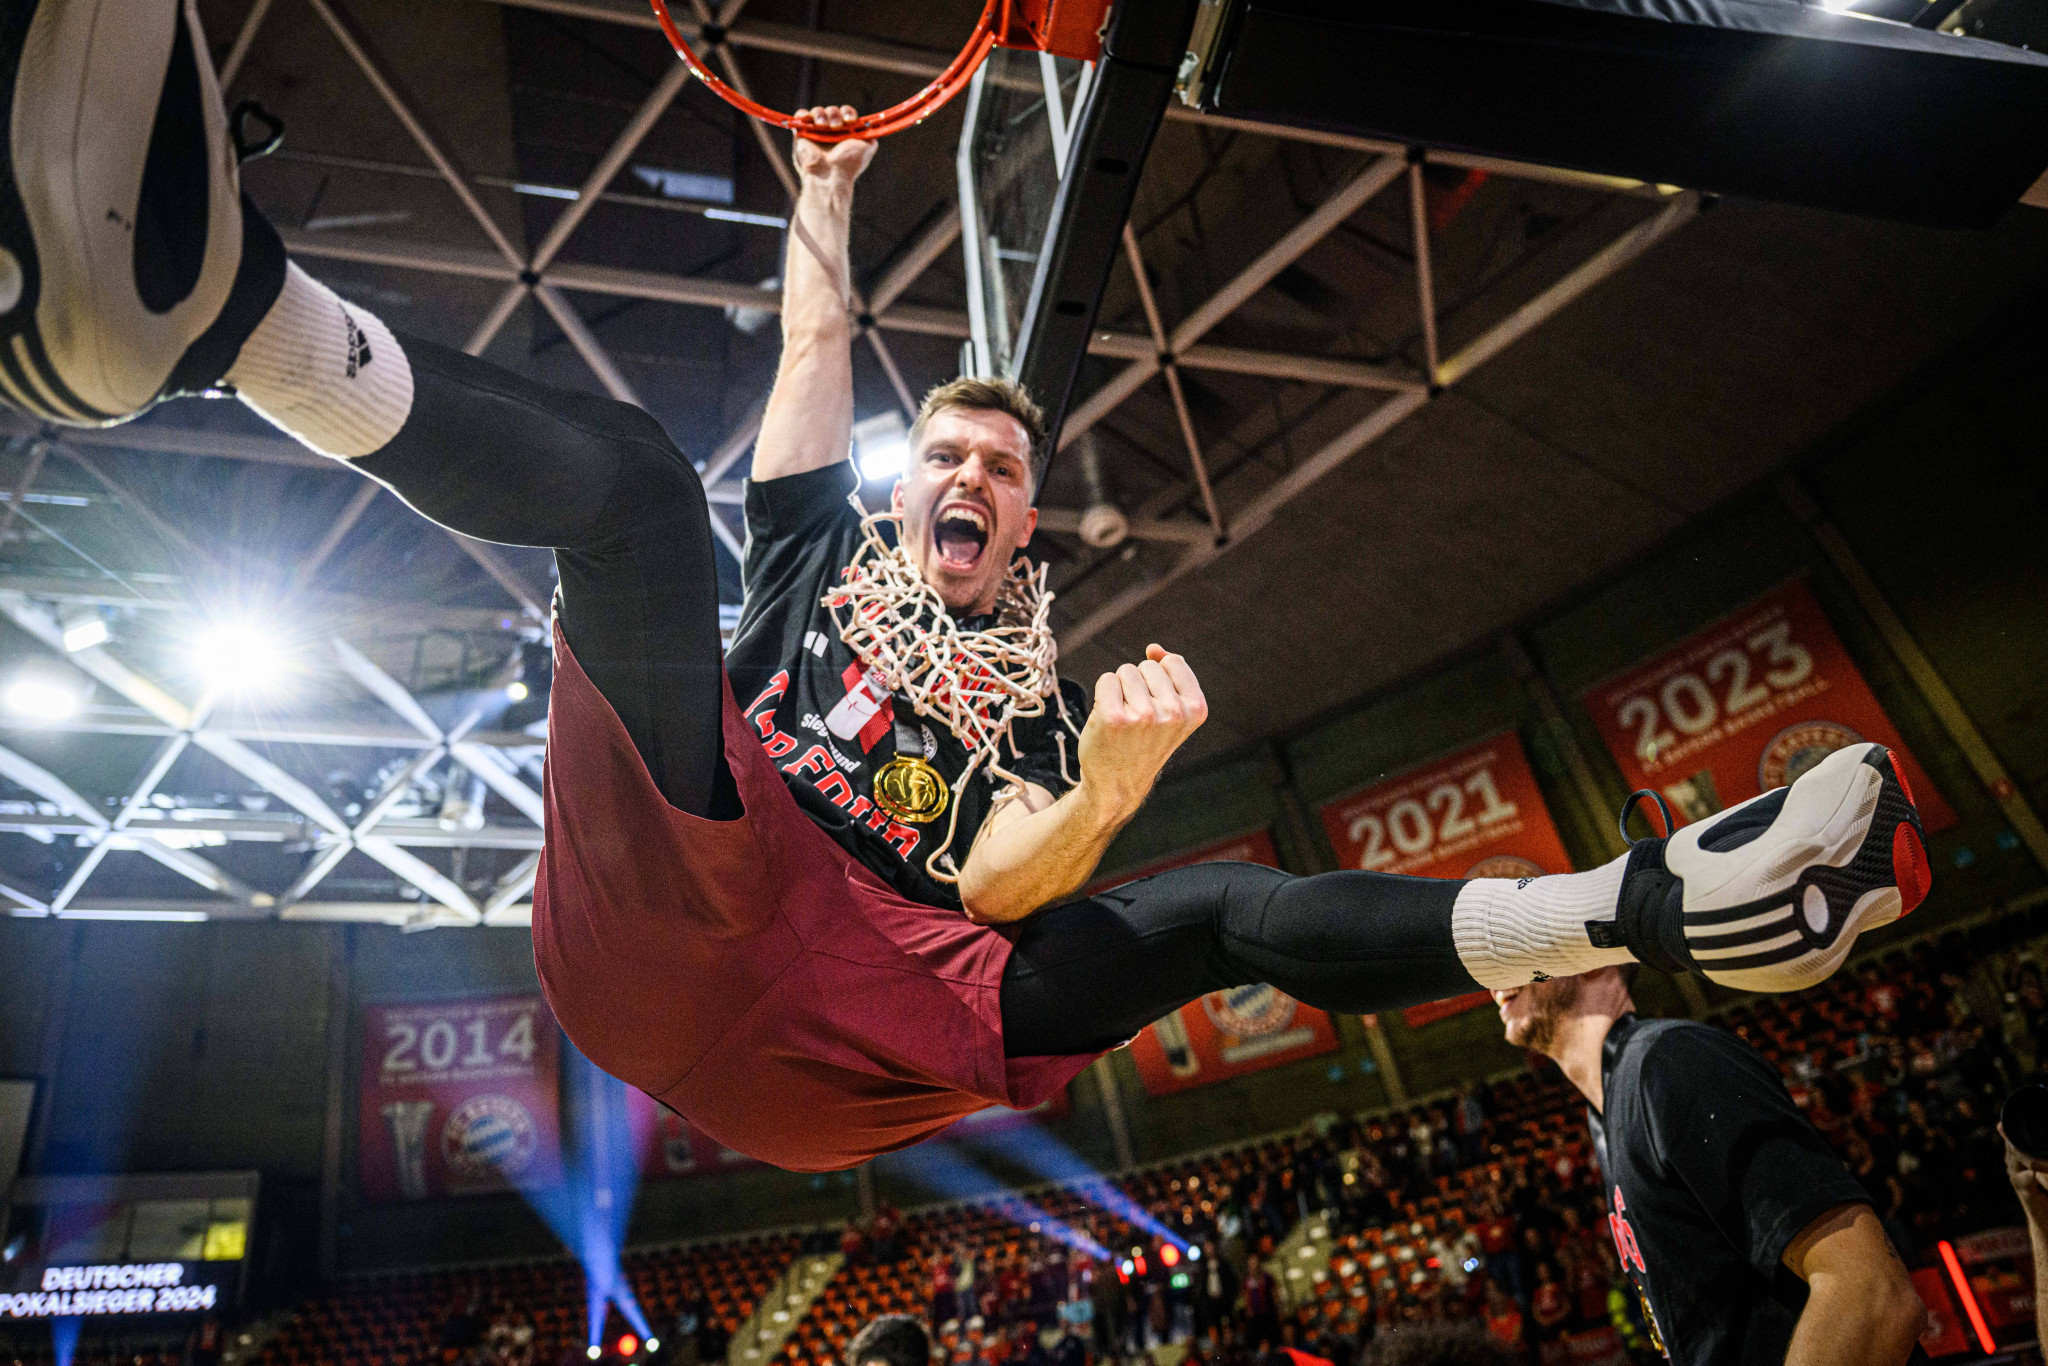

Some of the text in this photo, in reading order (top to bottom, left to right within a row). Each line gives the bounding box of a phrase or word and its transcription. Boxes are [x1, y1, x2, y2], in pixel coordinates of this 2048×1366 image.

[1618, 620, 1814, 758] 2023
[801, 713, 861, 773] siegund
[1350, 770, 1517, 870] 2021
[383, 1014, 538, 1071] 2014
[0, 1284, 217, 1317] POKALSIEGER 2024
[41, 1263, 184, 1291] DEUTSCHER
